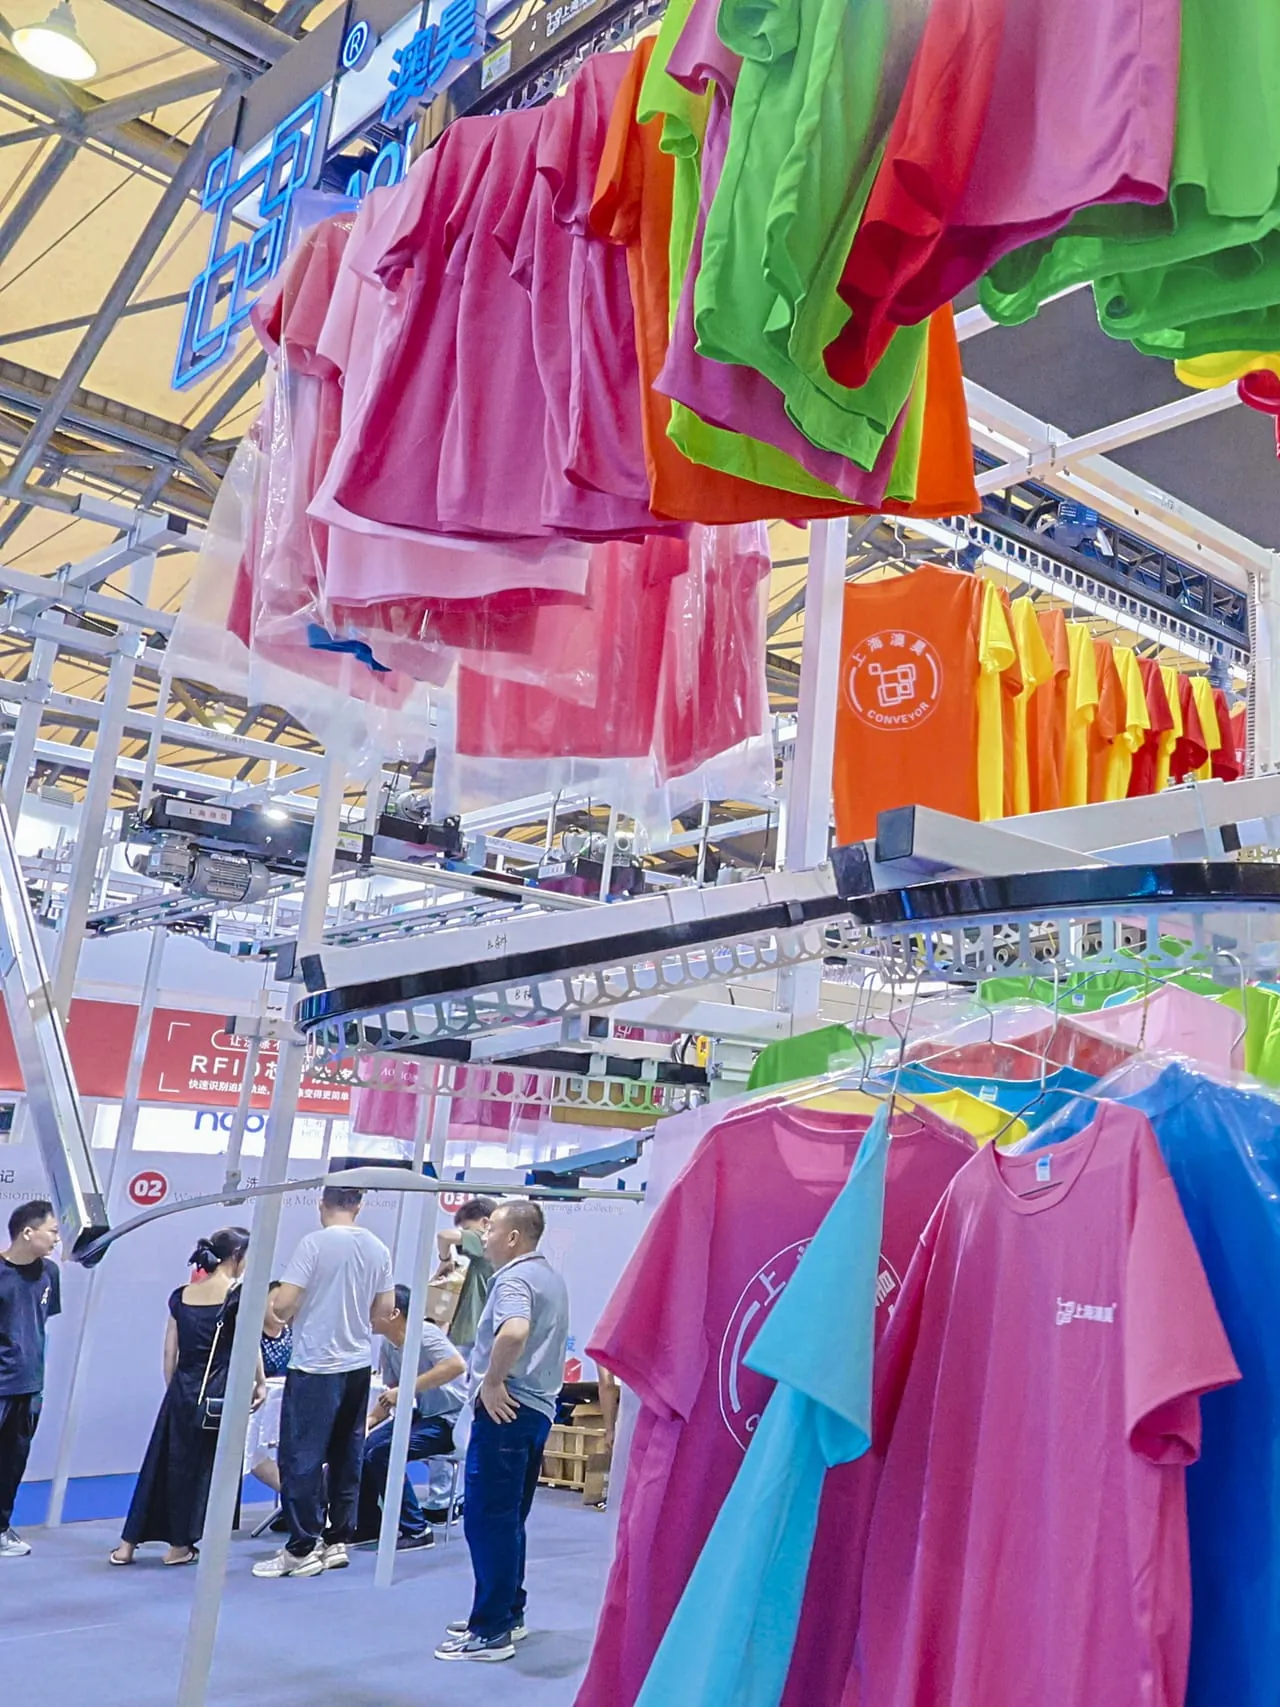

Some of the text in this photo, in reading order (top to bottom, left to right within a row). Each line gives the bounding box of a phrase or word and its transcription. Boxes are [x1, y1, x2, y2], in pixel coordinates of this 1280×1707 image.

[866, 701, 930, 725] CONVEYOR
[134, 1180, 163, 1198] 02
[443, 1192, 465, 1206] 03
